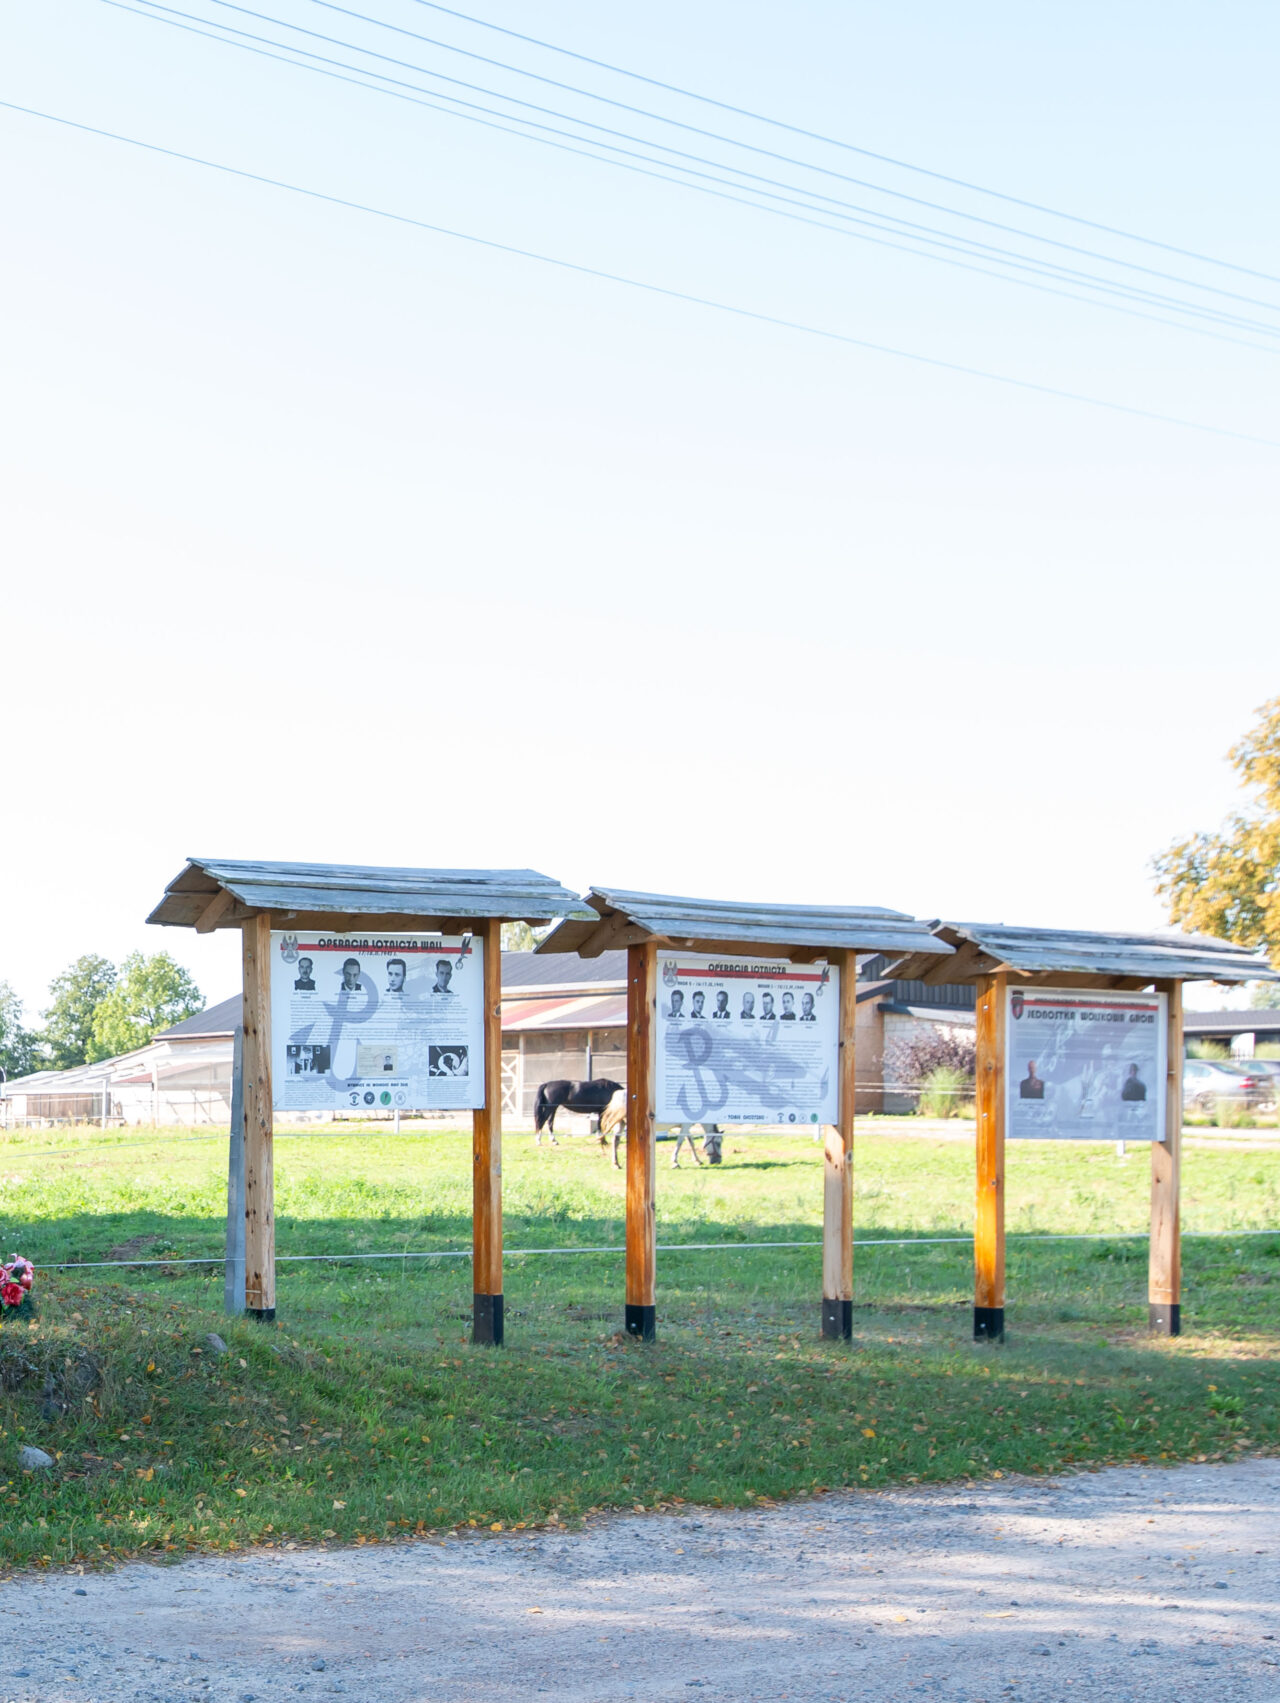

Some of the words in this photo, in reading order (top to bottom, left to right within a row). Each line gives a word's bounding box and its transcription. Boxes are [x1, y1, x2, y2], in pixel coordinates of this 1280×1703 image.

[318, 938, 369, 948] OPERACJA
[372, 939, 418, 949] LOTNICZA
[421, 941, 442, 950] WALL
[708, 963, 748, 973] OPERACJA
[751, 965, 786, 974] LOTNICZA
[1027, 1010, 1076, 1020] JEDNOSTKA
[1080, 1012, 1125, 1022] WOJSKOWA
[1129, 1014, 1154, 1023] GROM
